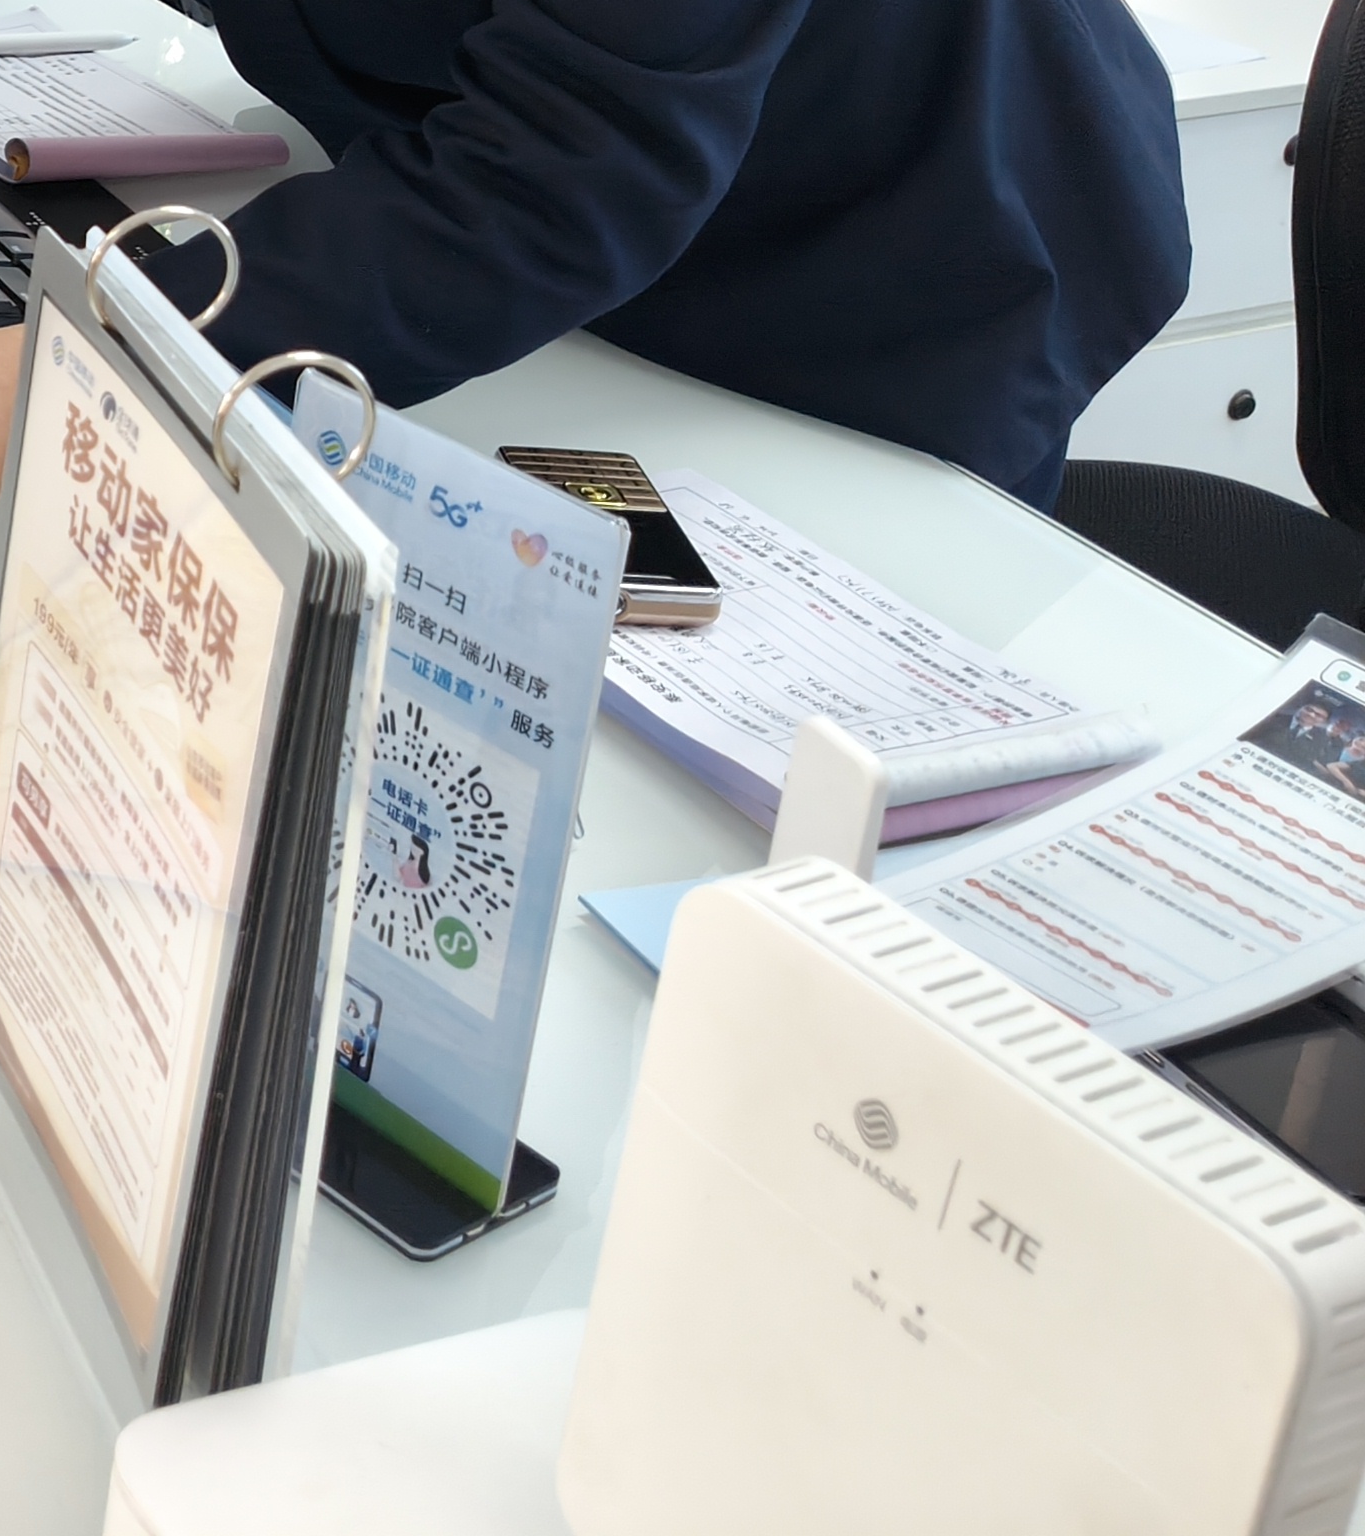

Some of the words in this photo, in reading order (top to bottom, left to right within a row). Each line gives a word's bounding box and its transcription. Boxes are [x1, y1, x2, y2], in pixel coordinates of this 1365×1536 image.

[364, 452, 416, 491] 国移动
[62, 400, 239, 683] 移动家保保
[68, 494, 214, 724] 让生活更美好
[402, 562, 468, 615] 扫一扫
[366, 597, 550, 701] 院客户端小程序
[382, 777, 429, 817] 电话卡
[814, 1122, 861, 1168] China
[863, 1156, 919, 1212] Mobile
[970, 1197, 1043, 1277] ZTE
